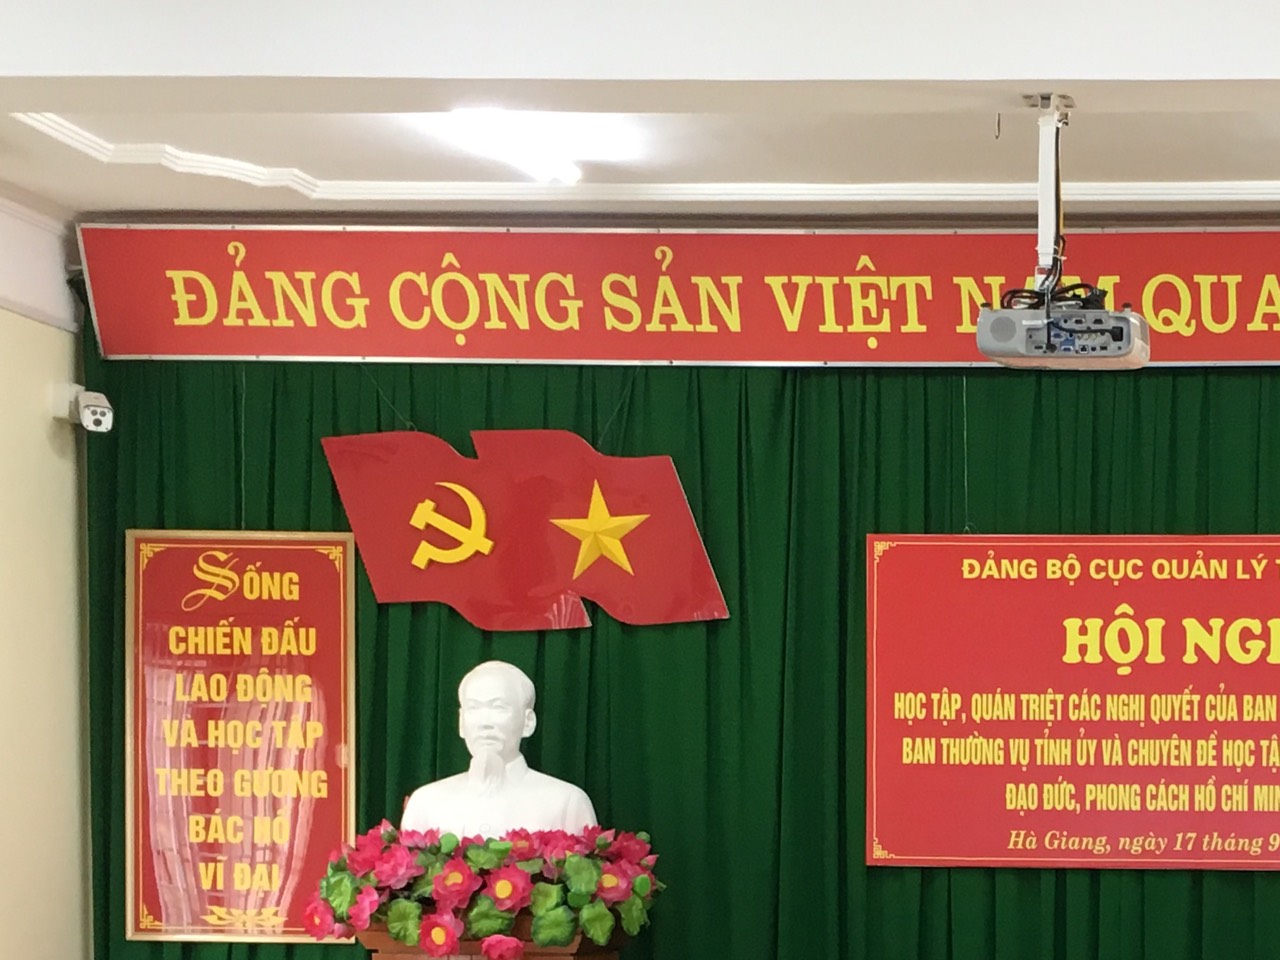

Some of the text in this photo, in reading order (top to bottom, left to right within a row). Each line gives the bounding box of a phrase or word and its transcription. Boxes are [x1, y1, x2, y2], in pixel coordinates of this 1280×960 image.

[166, 241, 370, 330] ĐẢNG
[388, 252, 584, 347] CỘNG
[602, 246, 742, 333] SẢN
[764, 255, 932, 349] VIỆT
[181, 551, 300, 612] SỐNG
[961, 550, 1038, 580] ĐẢNG
[1045, 553, 1082, 585] BỘ
[1088, 558, 1144, 585] CỤC
[1151, 550, 1228, 581] QUẢN
[1236, 554, 1268, 580] LÝ
[169, 617, 316, 656] CHIẾN ĐẤU
[1062, 603, 1165, 676] HỘI
[176, 667, 312, 708] LAO ĐỘNG
[894, 692, 927, 725] HỌC
[931, 687, 966, 724] TẬP,
[971, 688, 1015, 723] QUÁN
[1020, 688, 1064, 727] TRIỆT
[1068, 688, 1101, 721] CÁC
[1106, 694, 1145, 727] NGHỊ
[1150, 684, 1200, 724] QUYẾT
[1205, 683, 1238, 722] CỦA
[1243, 695, 1277, 722] BAN
[163, 714, 324, 755] VÀ HỌC TẬP
[902, 737, 936, 764] BAN
[941, 731, 1004, 765] THƯỜNG
[1009, 739, 1030, 771] VỤ
[1035, 728, 1072, 766] TỈNH
[1077, 727, 1097, 766] ỦY
[1102, 734, 1123, 766] VÀ
[1127, 734, 1191, 766] CHUYÊN
[1196, 729, 1217, 767] ĐỀ
[1222, 740, 1255, 773] HỌC
[155, 766, 328, 798] THEO GƯƠNG
[1006, 783, 1038, 816] ĐẠO
[1043, 775, 1081, 814] ĐỨC,
[1086, 784, 1141, 811] PHONG
[1146, 778, 1190, 812] CÁCH
[1194, 775, 1216, 812] HỒ
[1221, 779, 1249, 812] CHÍ
[189, 808, 244, 843] BÁC
[1007, 830, 1038, 850] Hà
[1044, 831, 1112, 855] Giang,
[1118, 833, 1168, 855] ngày
[1173, 833, 1197, 851] 17
[1202, 832, 1263, 856] tháng
[1268, 834, 1280, 853] 9
[199, 856, 280, 898] VĨ ĐẠI
